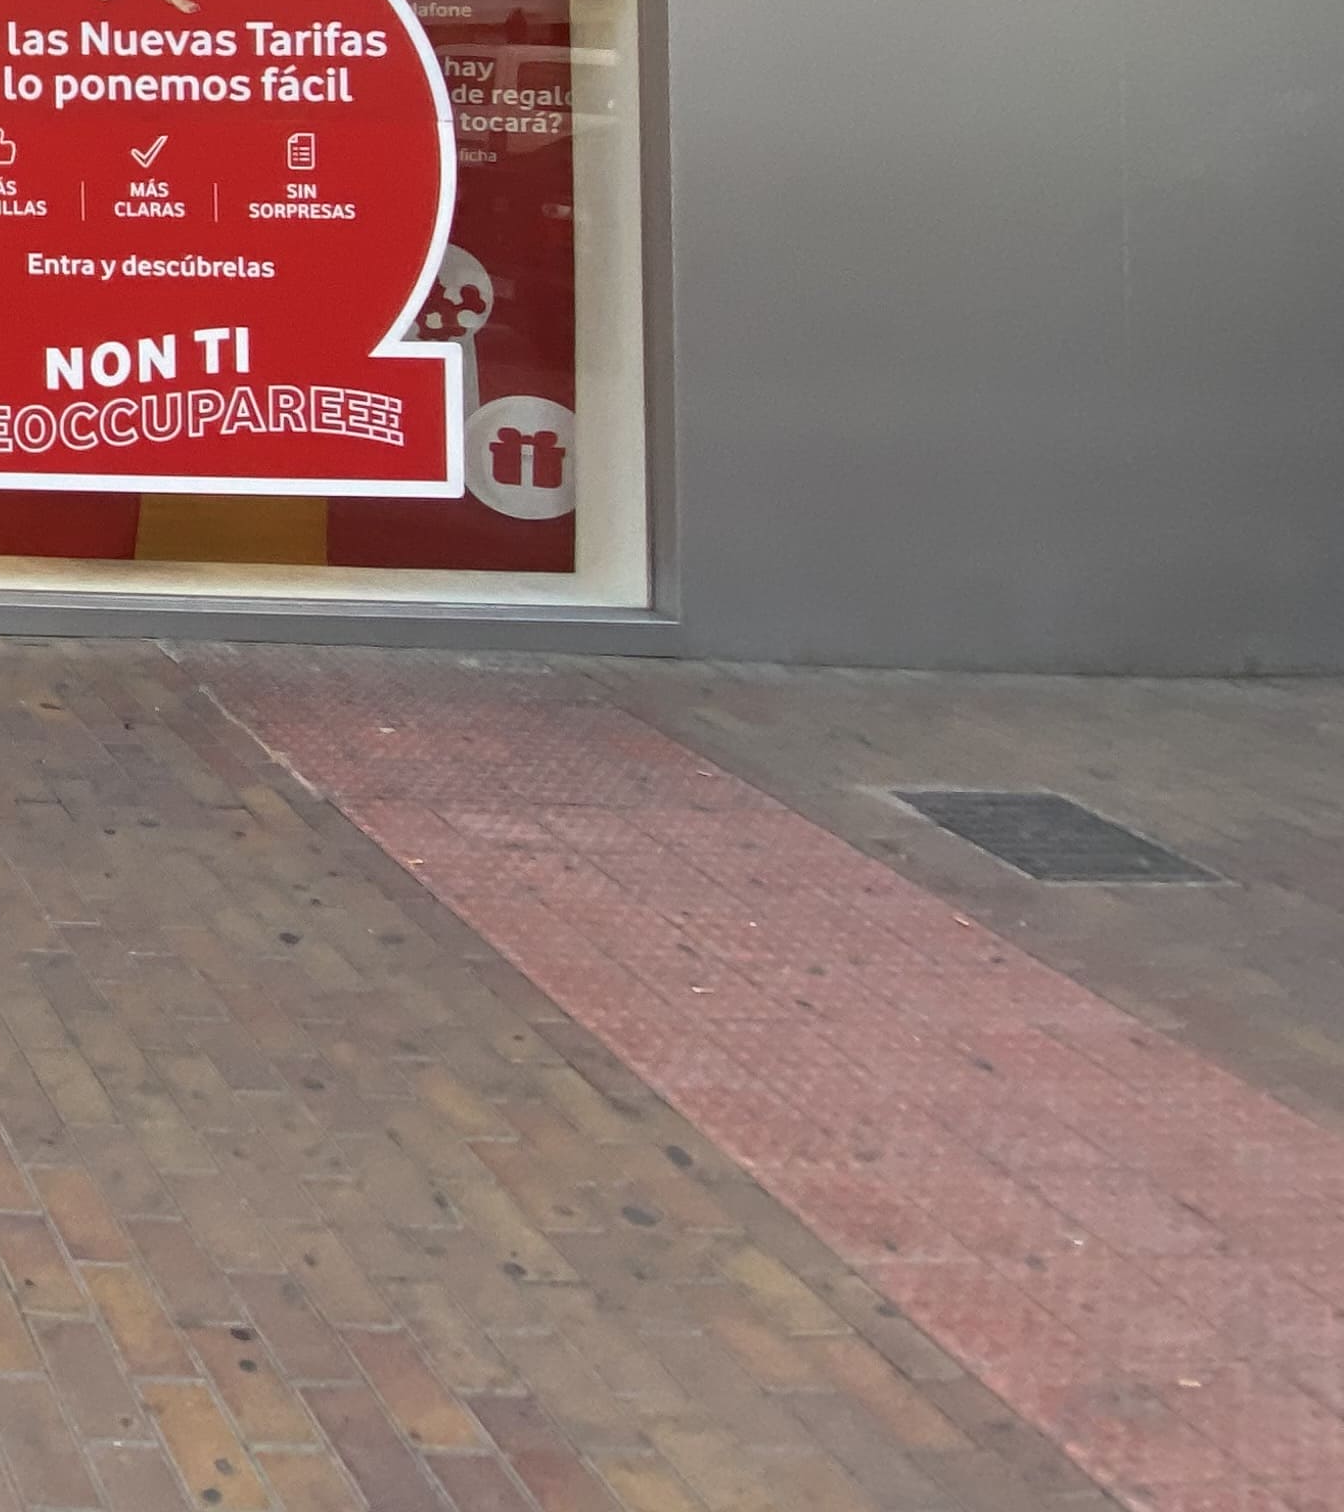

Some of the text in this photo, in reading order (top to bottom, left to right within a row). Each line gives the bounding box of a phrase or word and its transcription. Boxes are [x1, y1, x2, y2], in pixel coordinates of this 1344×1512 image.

[9, 21, 69, 56] las
[81, 22, 237, 57] Nuevas
[246, 21, 388, 59] Tarifas
[444, 56, 495, 81] hay
[3, 67, 42, 101] lo
[54, 73, 252, 109] ponemos
[261, 65, 353, 103] fácil
[451, 85, 485, 104] de
[459, 112, 563, 134] tocará?
[129, 178, 170, 198] MÁS
[286, 183, 317, 199] SIN
[114, 201, 186, 219] CLARAS
[248, 202, 357, 221] SORPRESAS
[28, 253, 276, 281] Entra y descúbrelas
[45, 326, 251, 391] NON TI
